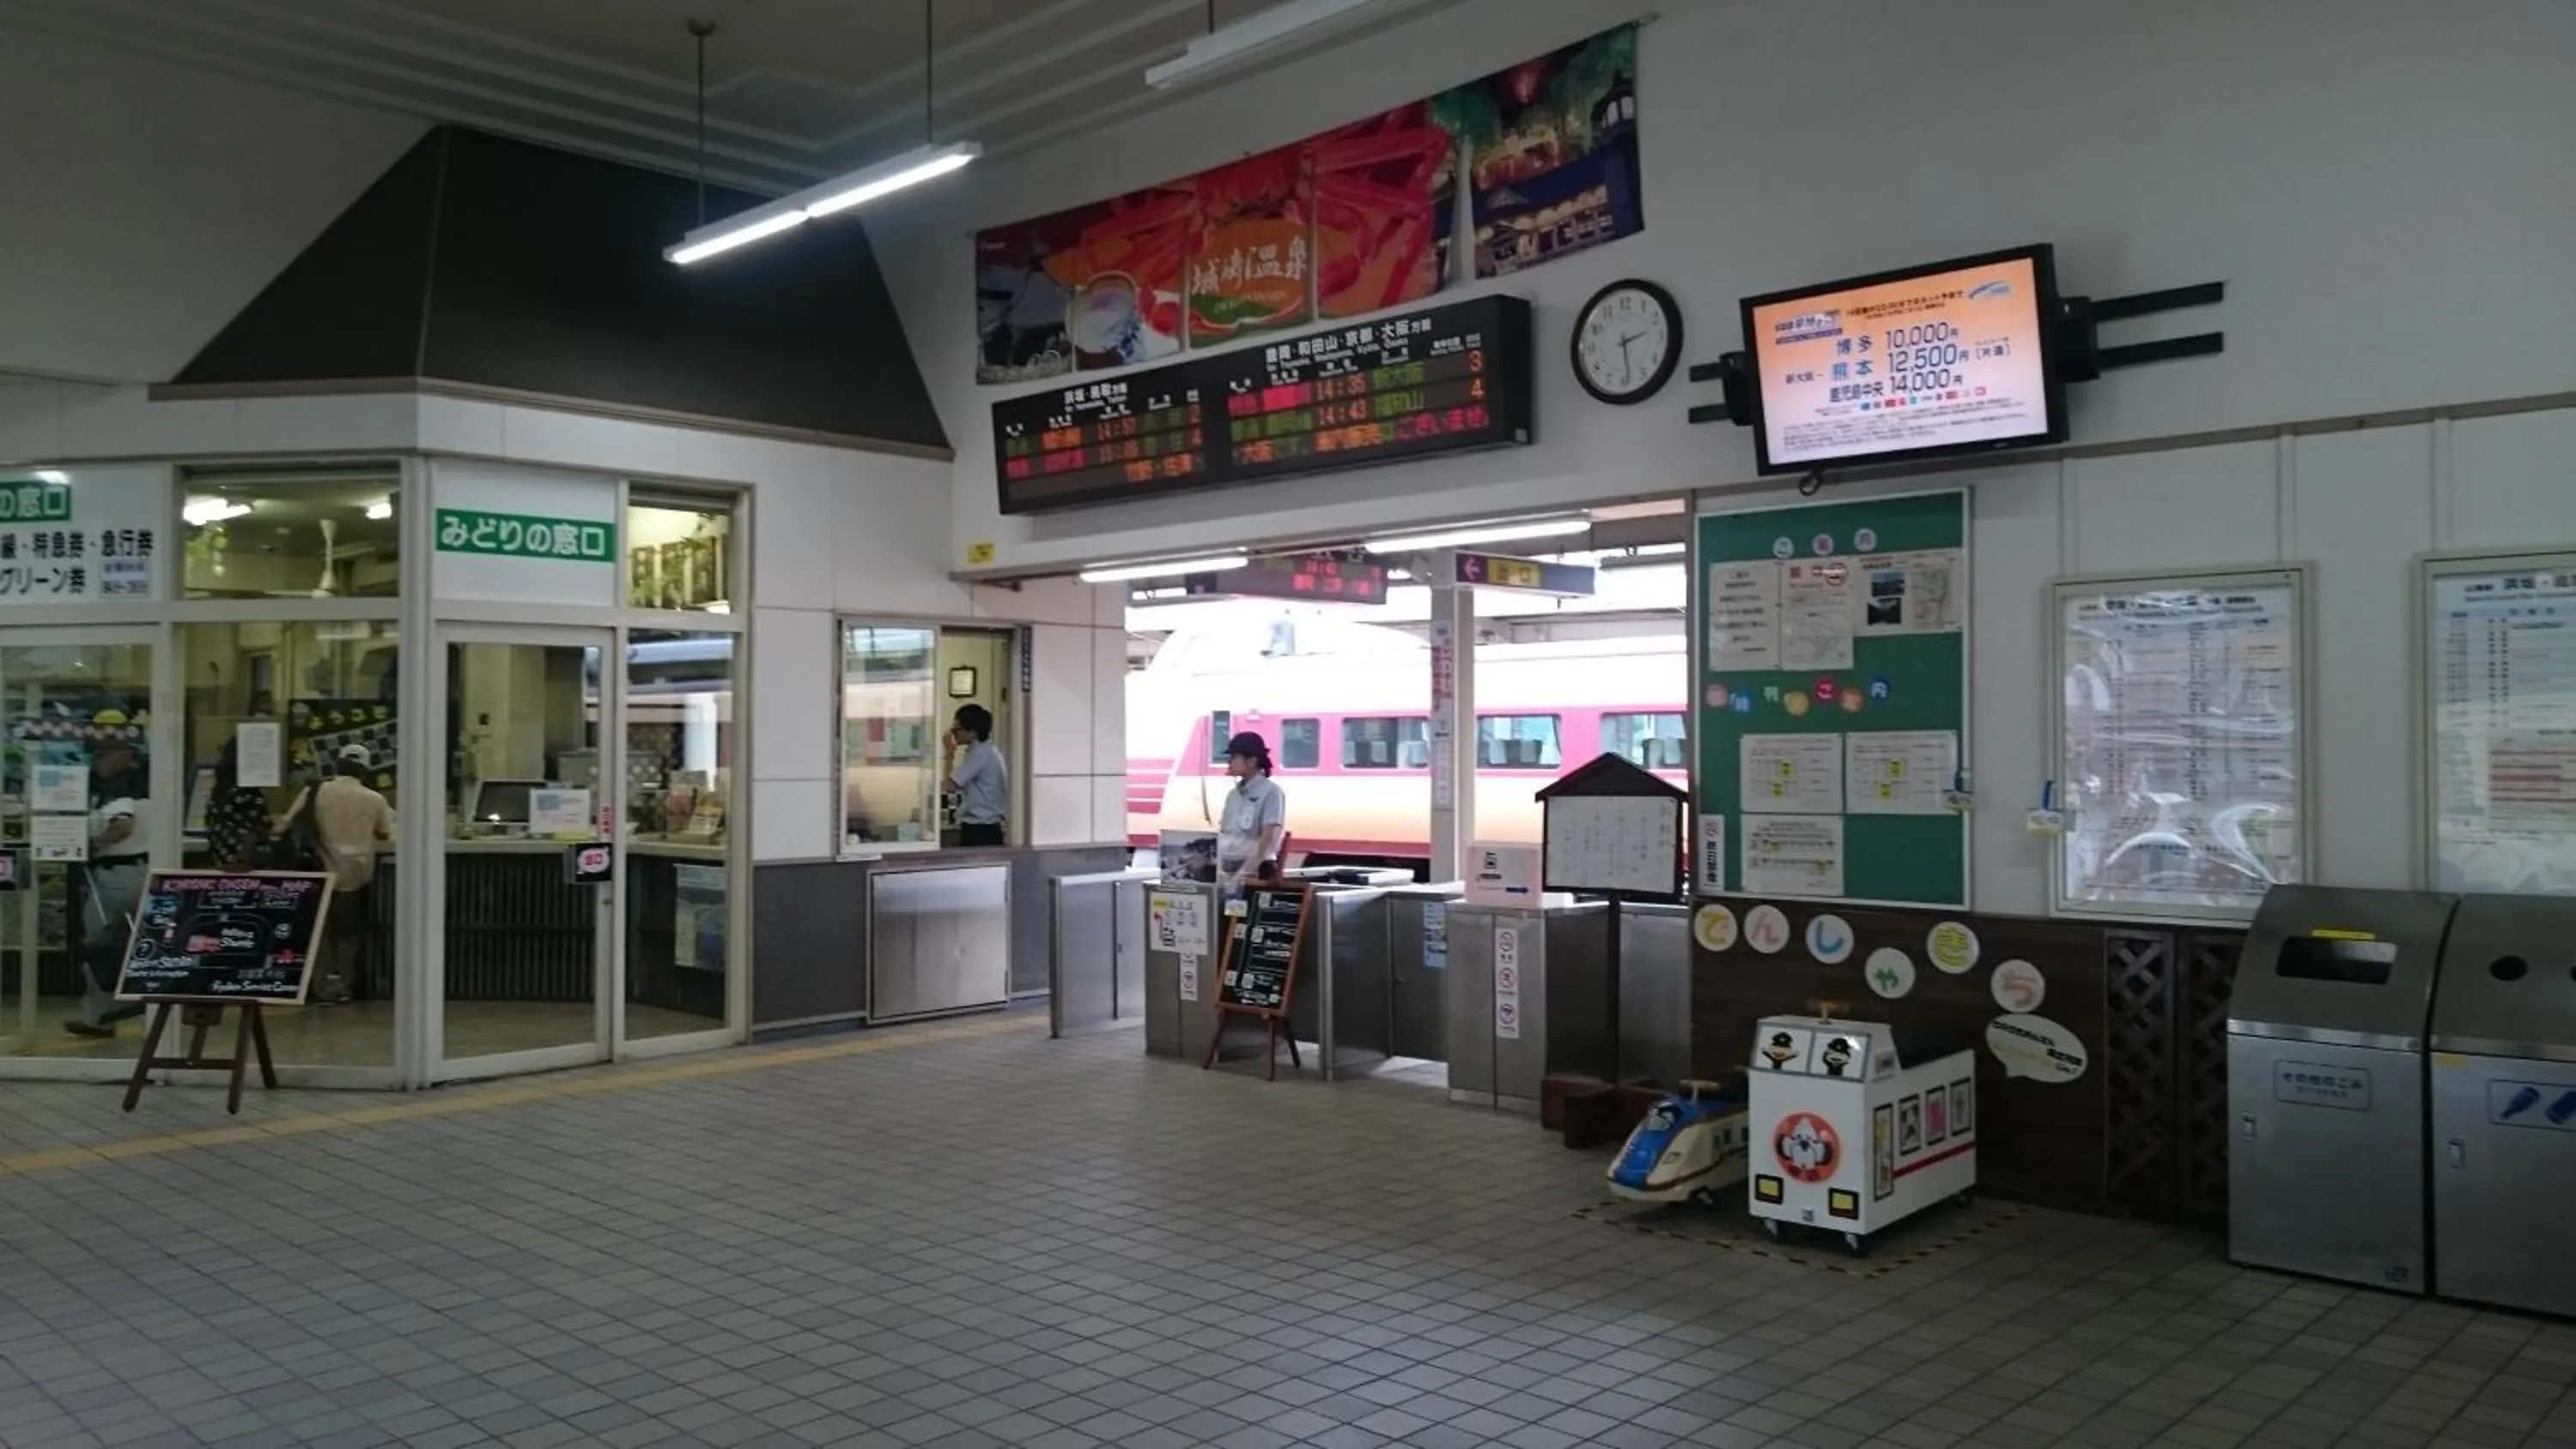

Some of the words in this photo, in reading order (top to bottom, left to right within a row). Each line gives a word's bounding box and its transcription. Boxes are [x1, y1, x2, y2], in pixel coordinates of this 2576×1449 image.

[1468, 349, 1483, 372] 3
[1470, 379, 1484, 399] 4
[440, 515, 605, 556] みどりの窓口
